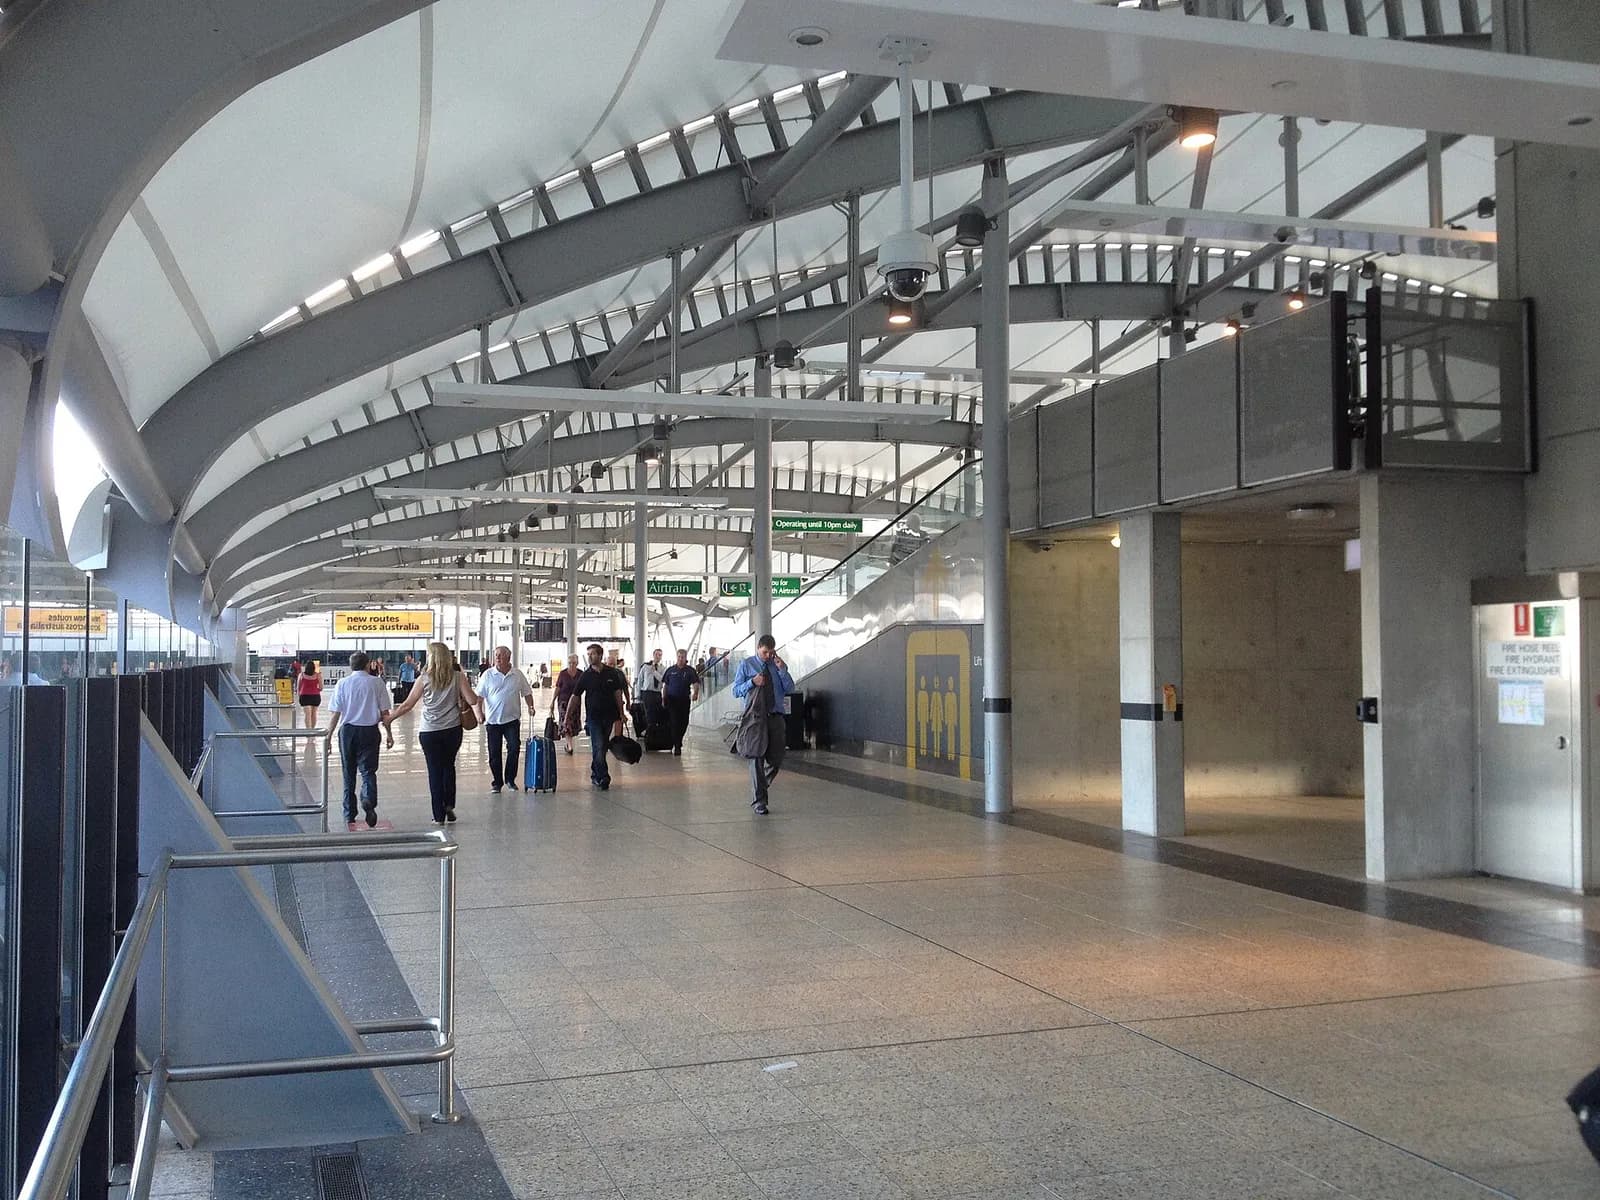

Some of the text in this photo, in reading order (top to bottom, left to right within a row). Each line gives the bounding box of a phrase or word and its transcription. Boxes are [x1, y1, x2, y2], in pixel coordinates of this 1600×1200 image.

[775, 520, 808, 529] Operating
[824, 521, 841, 530] 10pm
[842, 522, 858, 530] daily
[648, 582, 690, 593] Airtrain
[369, 615, 400, 623] routes
[379, 623, 420, 631] australia
[1502, 644, 1518, 653] FIRE
[1505, 655, 1560, 664] FIRE HYDRANT
[330, 669, 345, 678] Lift
[1489, 666, 1560, 675] FIRE EXTINGUISHER
